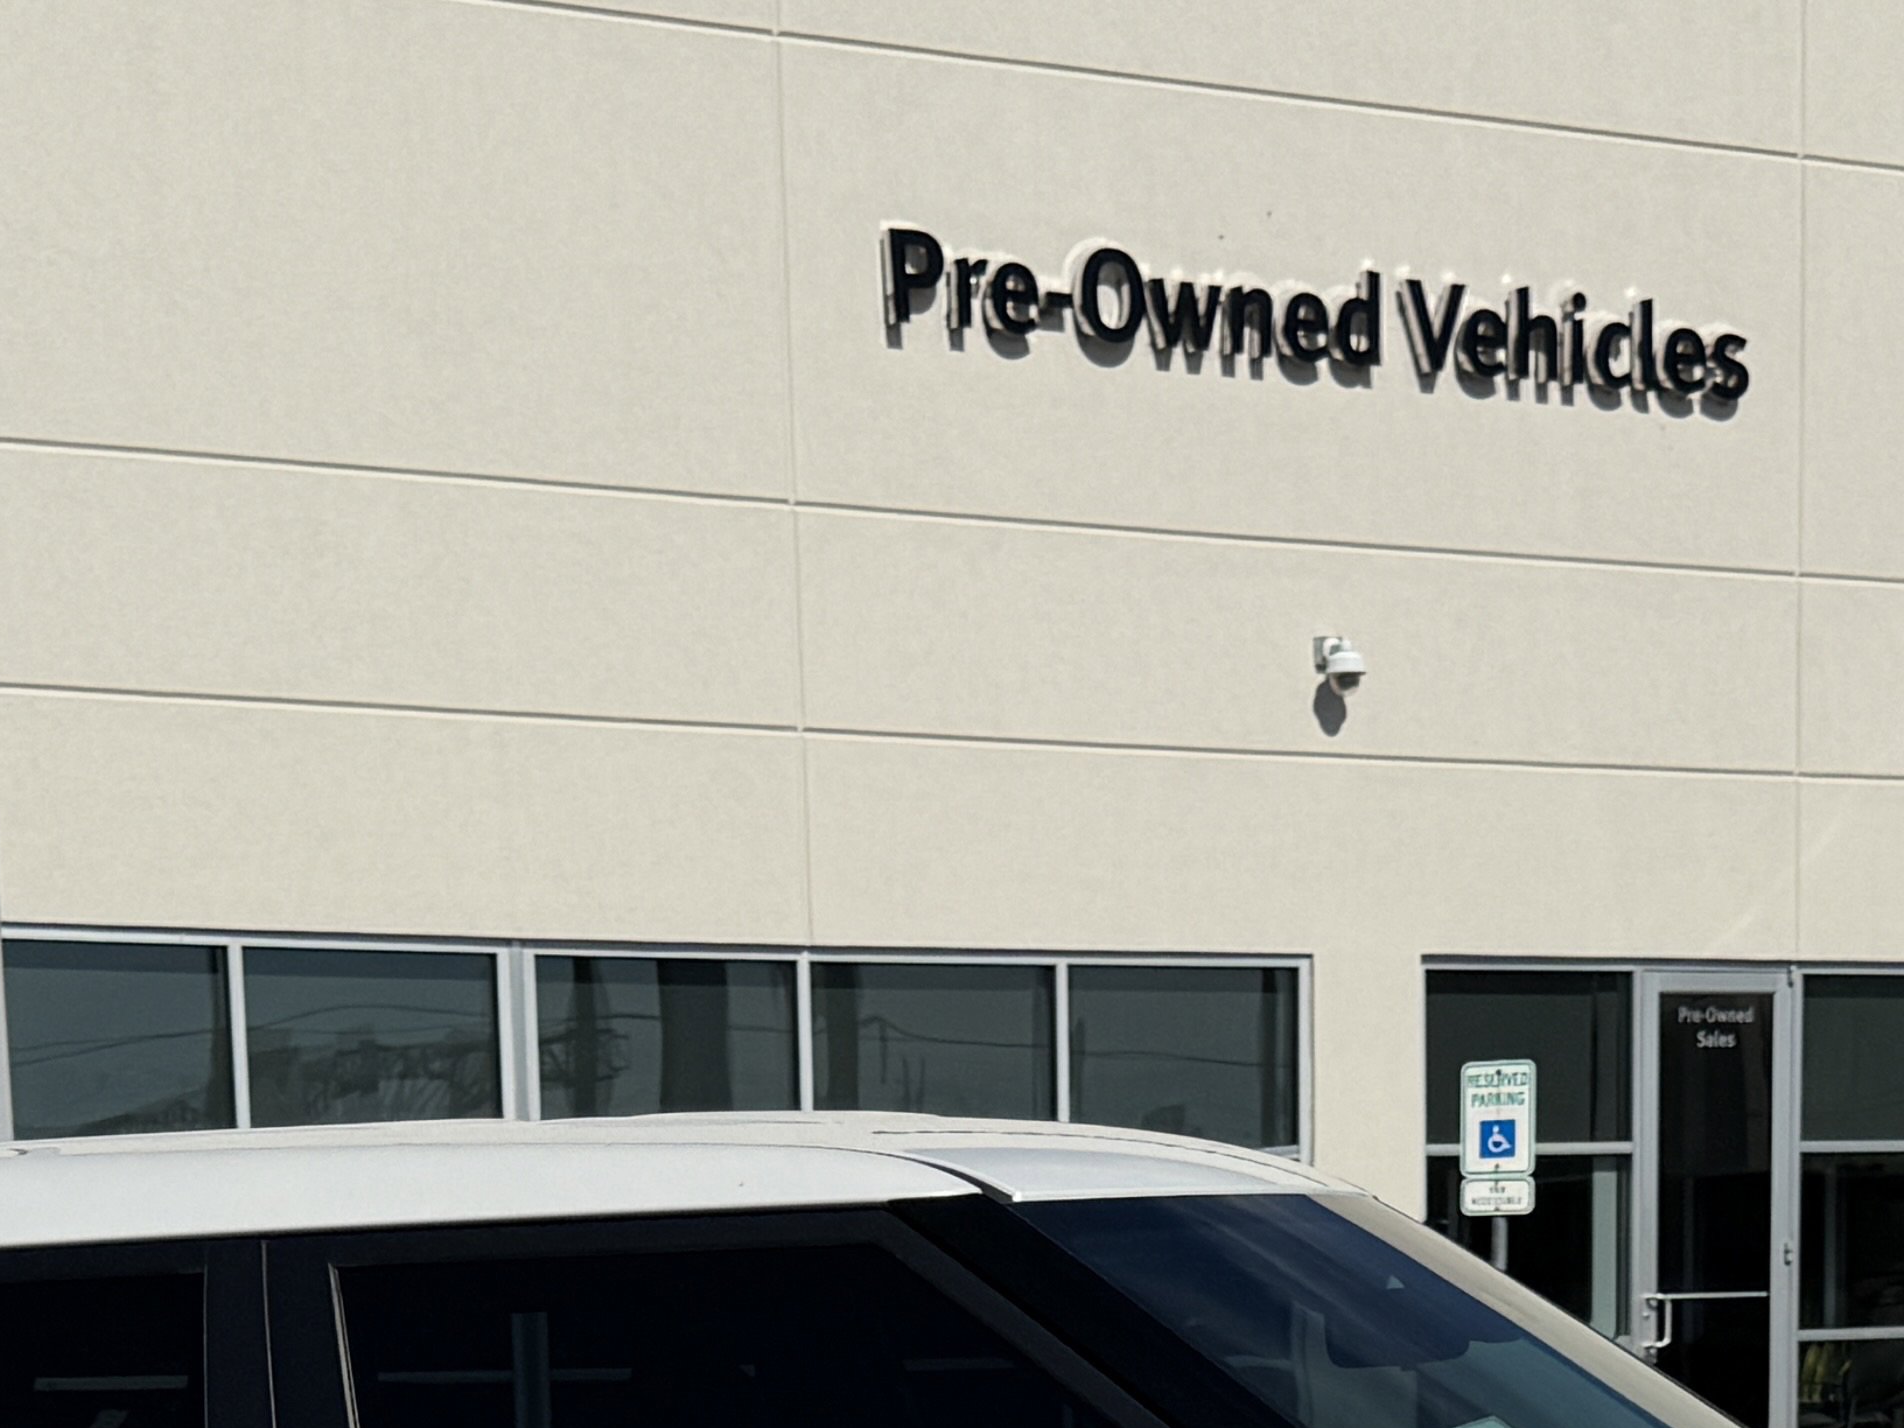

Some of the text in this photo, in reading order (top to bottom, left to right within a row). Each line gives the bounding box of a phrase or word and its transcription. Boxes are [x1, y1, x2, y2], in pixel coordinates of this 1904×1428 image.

[880, 226, 1751, 404] Pre-Owned Vehicles
[1677, 1006, 1755, 1024] Pre-Owned
[1696, 1029, 1737, 1048] Sales
[1470, 1091, 1526, 1108] PARKING
